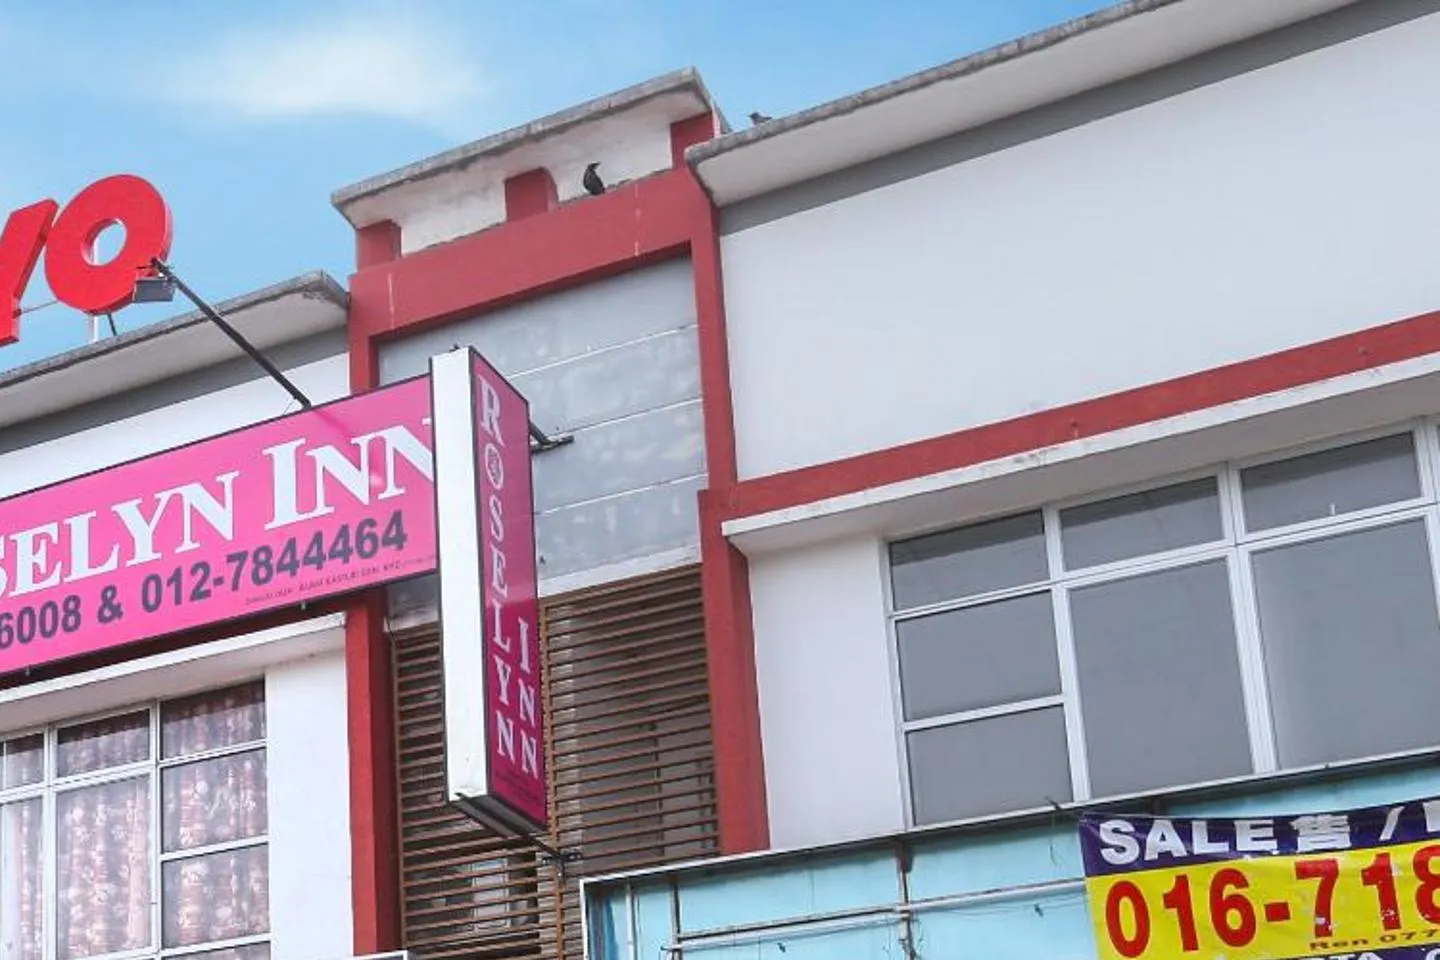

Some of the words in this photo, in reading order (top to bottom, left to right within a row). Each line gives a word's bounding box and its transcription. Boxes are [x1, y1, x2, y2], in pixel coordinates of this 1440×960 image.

[97, 584, 124, 625] &
[141, 509, 408, 614] 012-7844464
[476, 374, 517, 766] ROSELYN
[1099, 819, 1278, 865] SALE
